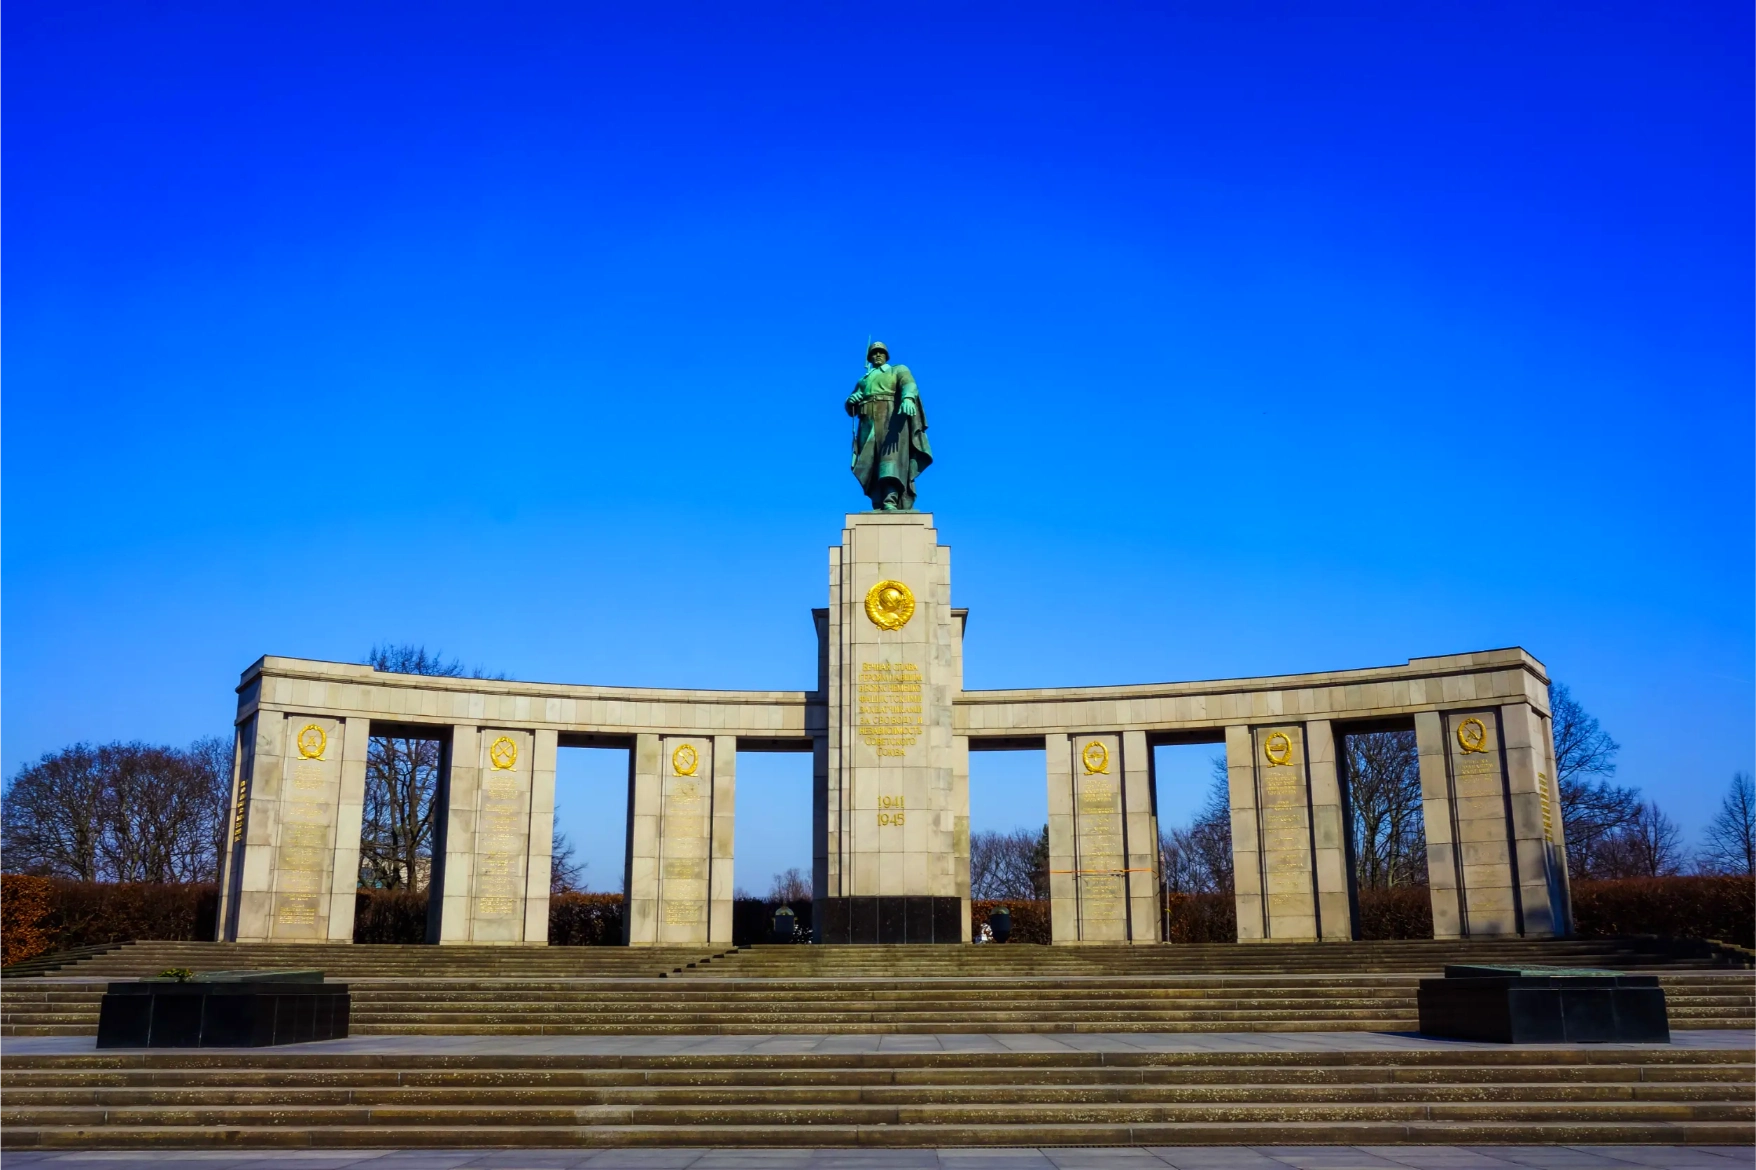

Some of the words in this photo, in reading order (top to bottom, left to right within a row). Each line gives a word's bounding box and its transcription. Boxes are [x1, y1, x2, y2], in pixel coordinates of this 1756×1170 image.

[860, 716, 870, 724] ЗА
[873, 716, 914, 724] СВОБОДУ
[877, 796, 904, 808] 1941
[877, 813, 904, 826] 1945
